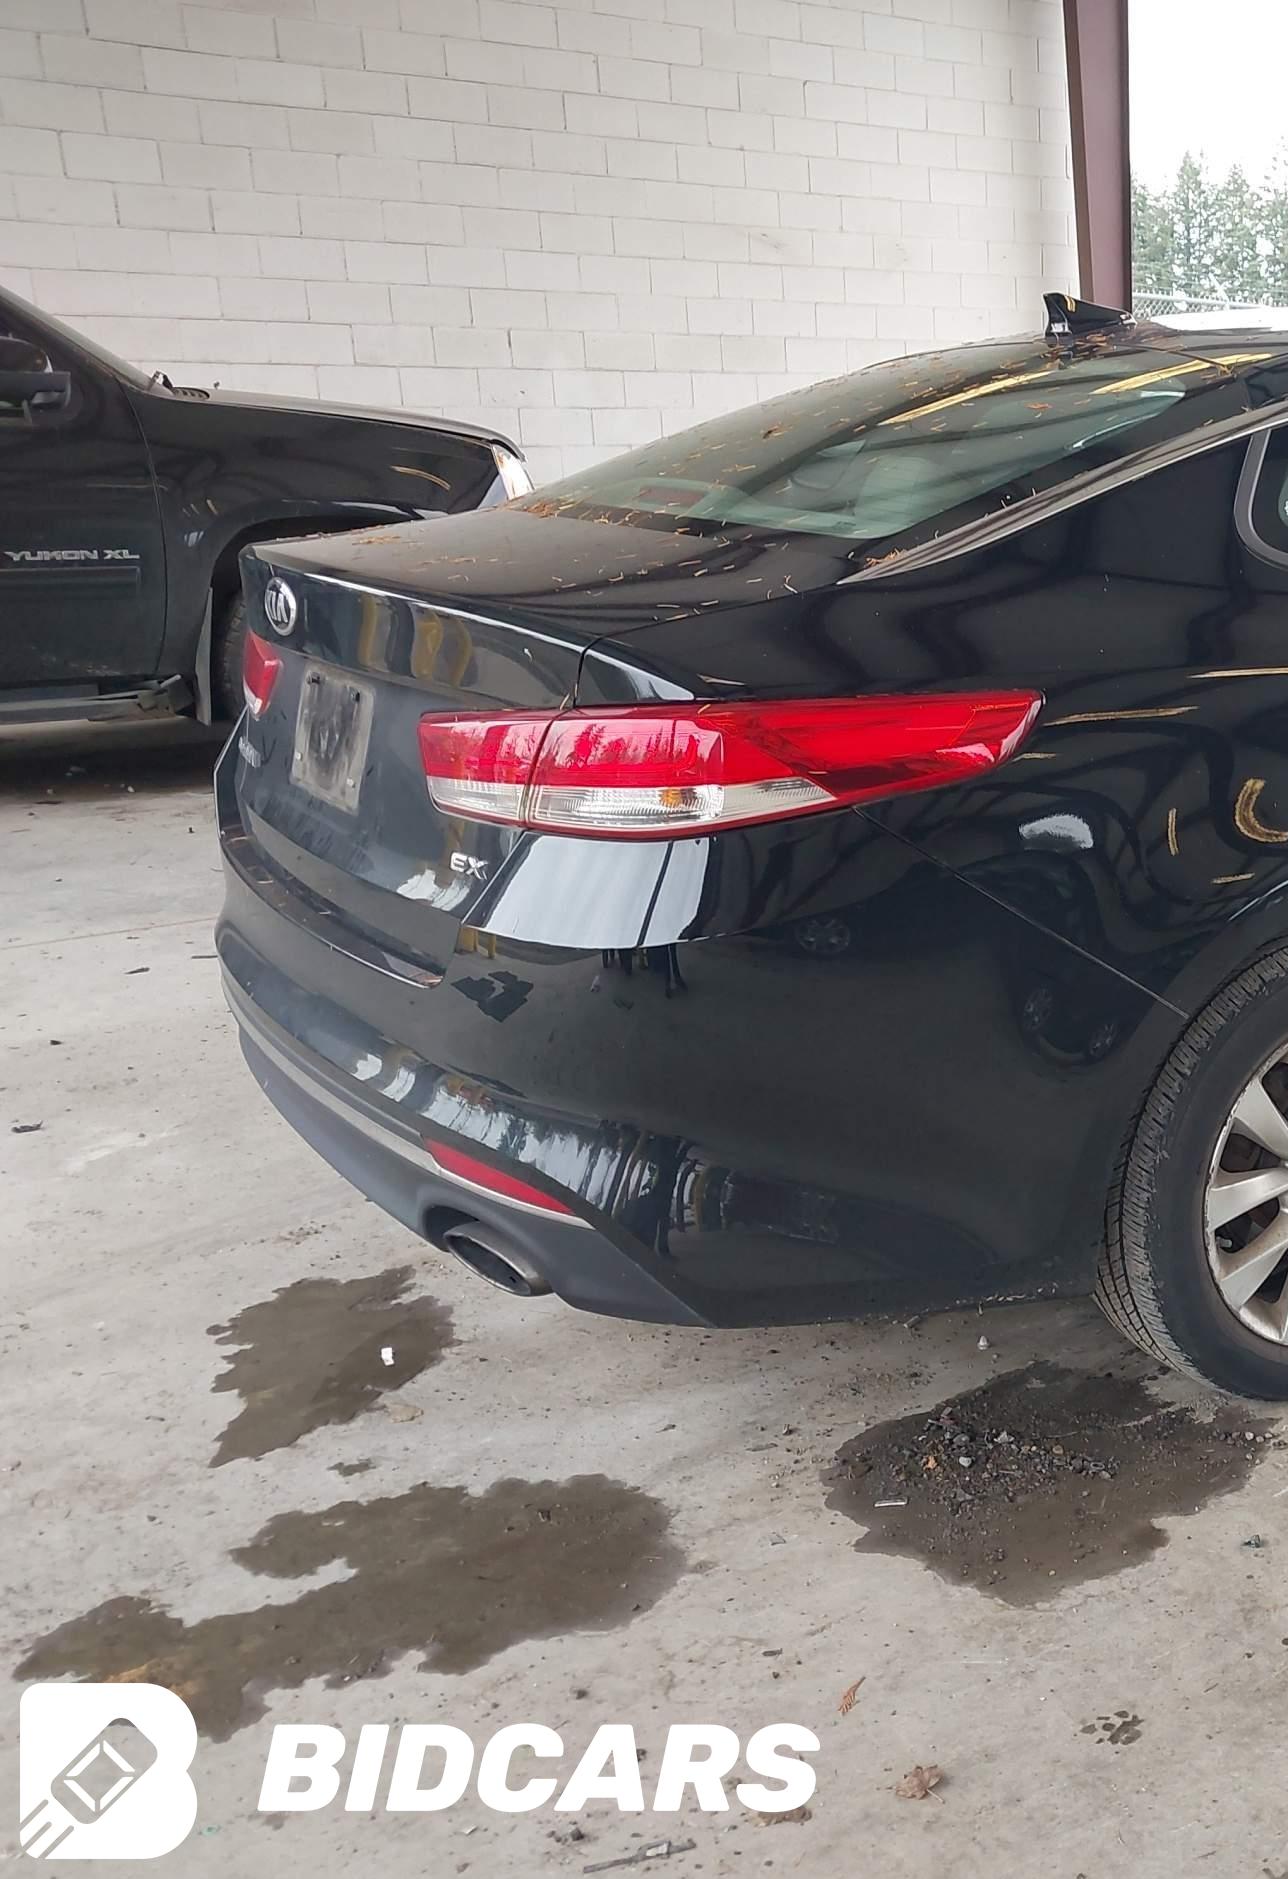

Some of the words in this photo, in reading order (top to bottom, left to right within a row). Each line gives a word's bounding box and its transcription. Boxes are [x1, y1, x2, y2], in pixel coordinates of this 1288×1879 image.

[4, 549, 99, 561] YUKON
[103, 549, 140, 560] XL
[450, 851, 489, 880] EX
